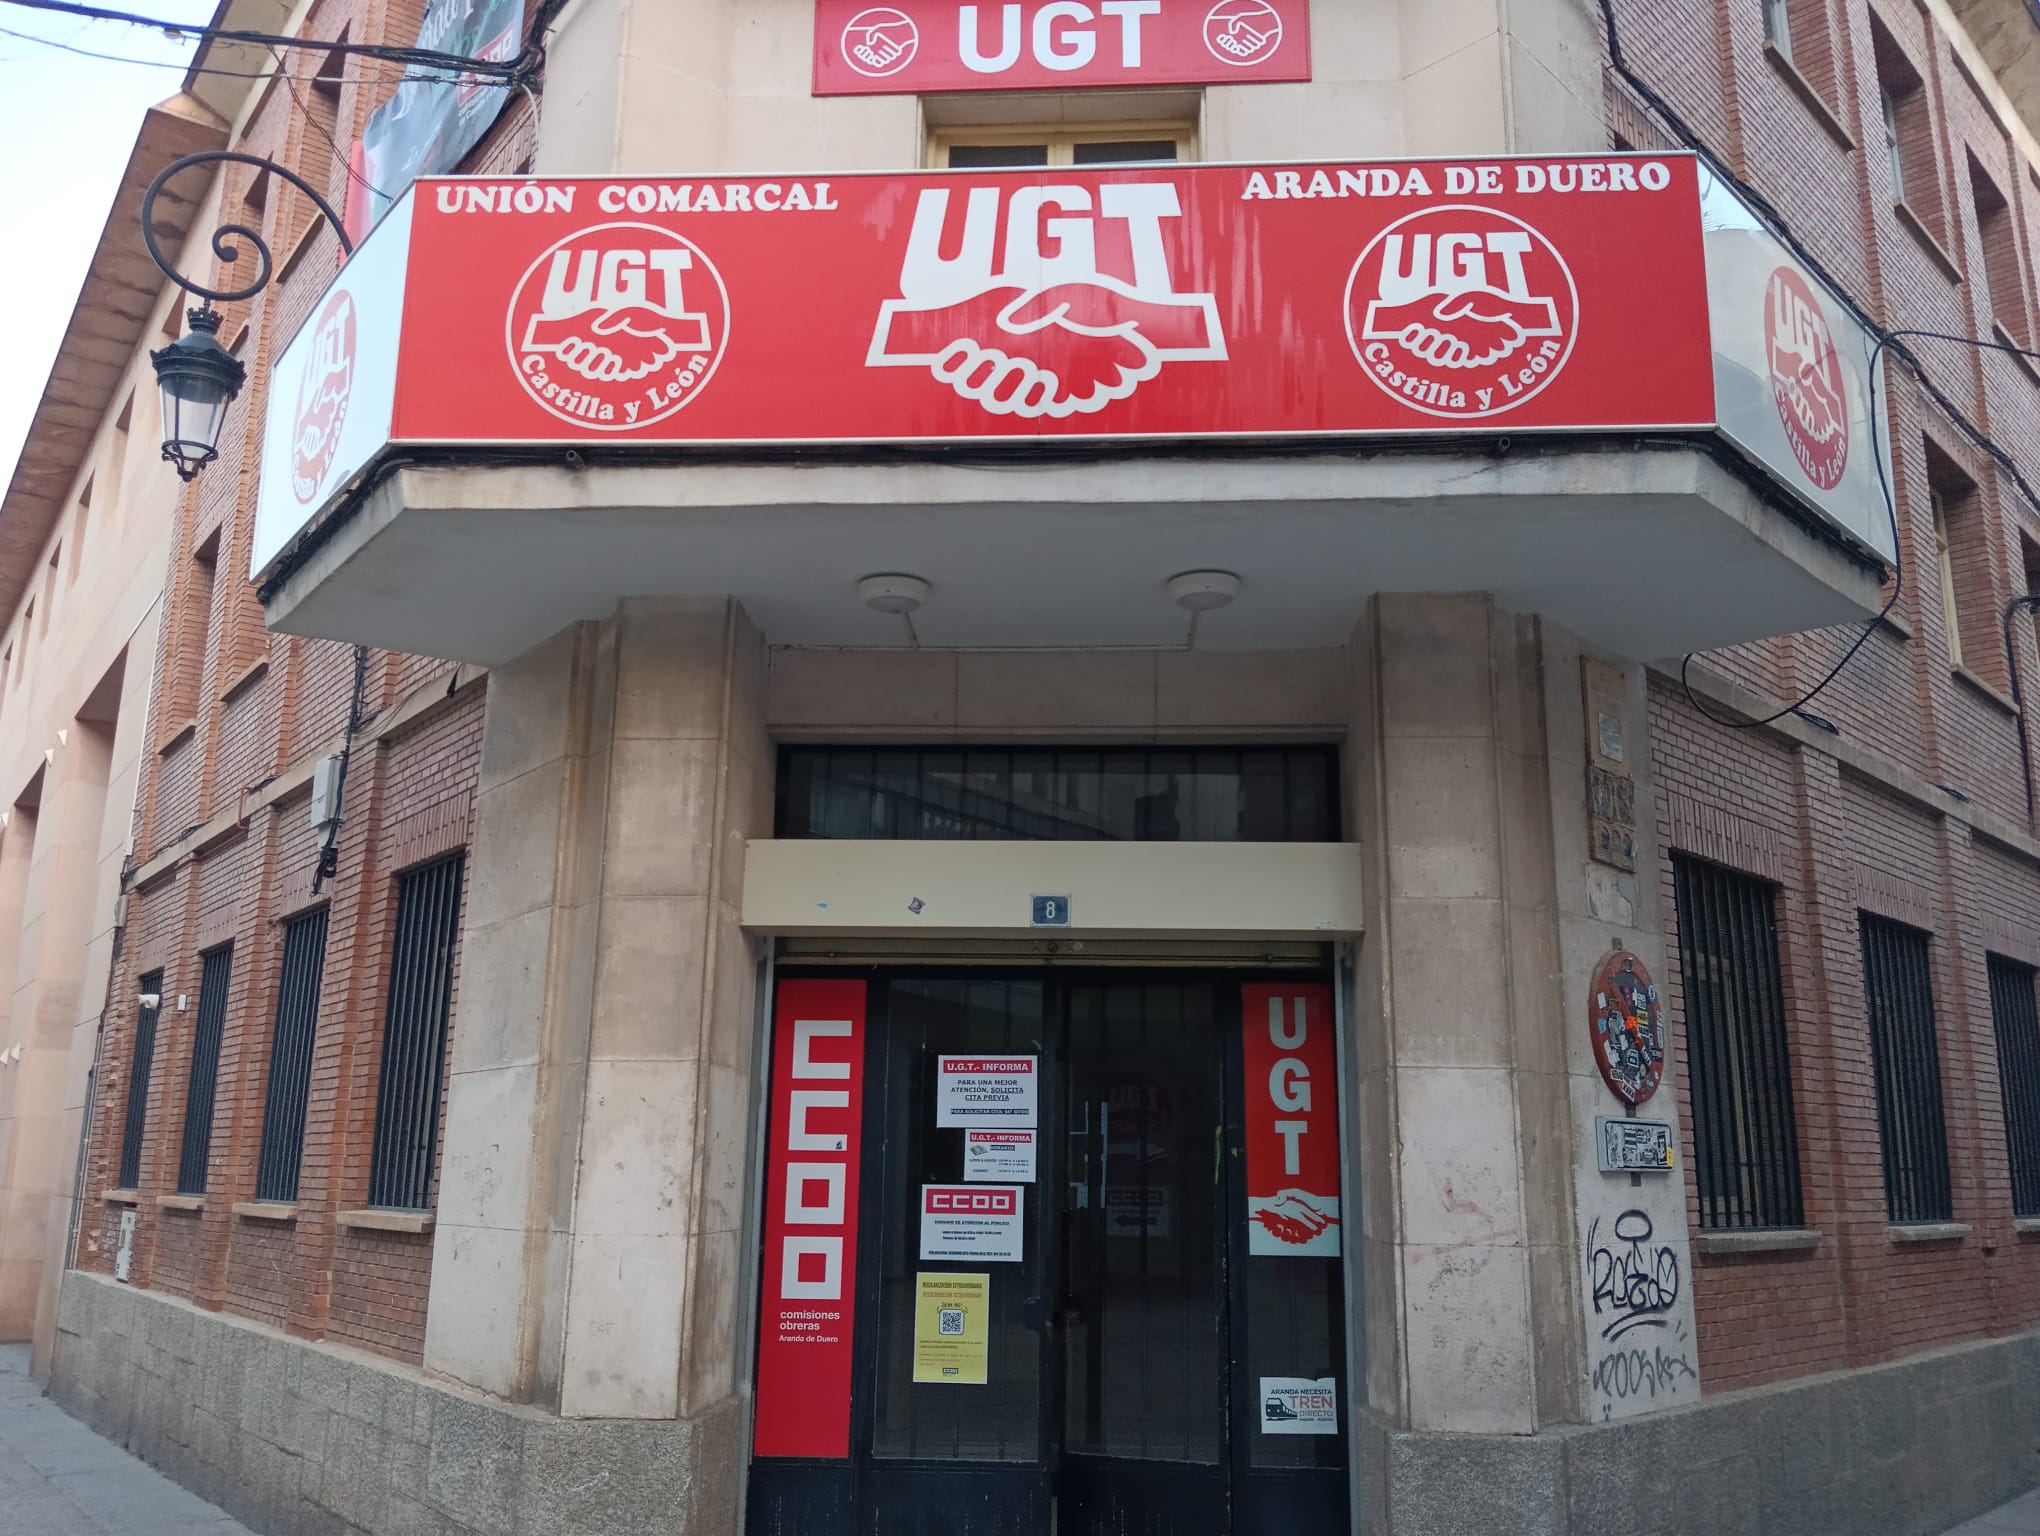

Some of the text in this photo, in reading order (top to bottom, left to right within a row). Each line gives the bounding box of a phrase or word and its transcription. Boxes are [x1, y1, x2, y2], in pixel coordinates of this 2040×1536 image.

[958, 0, 1161, 75] UGT
[436, 181, 838, 215] UNIÓN COMARCAL
[1241, 161, 1671, 201] ARANDA DE DUERO
[899, 182, 1183, 300] UGT
[1378, 231, 1533, 304] UGT
[541, 249, 694, 319] UGT
[1774, 274, 1831, 392] UGT
[522, 352, 708, 425] Castilla y León
[1364, 339, 1561, 412] Castilla y León
[1775, 382, 1817, 480] Castilla
[1826, 438, 1847, 482] León
[1046, 901, 1056, 919] 8
[982, 1063, 1028, 1071] INFORMA
[1268, 996, 1312, 1176] UGT
[780, 1020, 853, 1300] CCOO
[932, 1194, 1010, 1209] CCOO
[779, 1320, 820, 1330] obreras
[780, 1309, 840, 1319] comisiones
[1288, 1396, 1333, 1409] TREN
